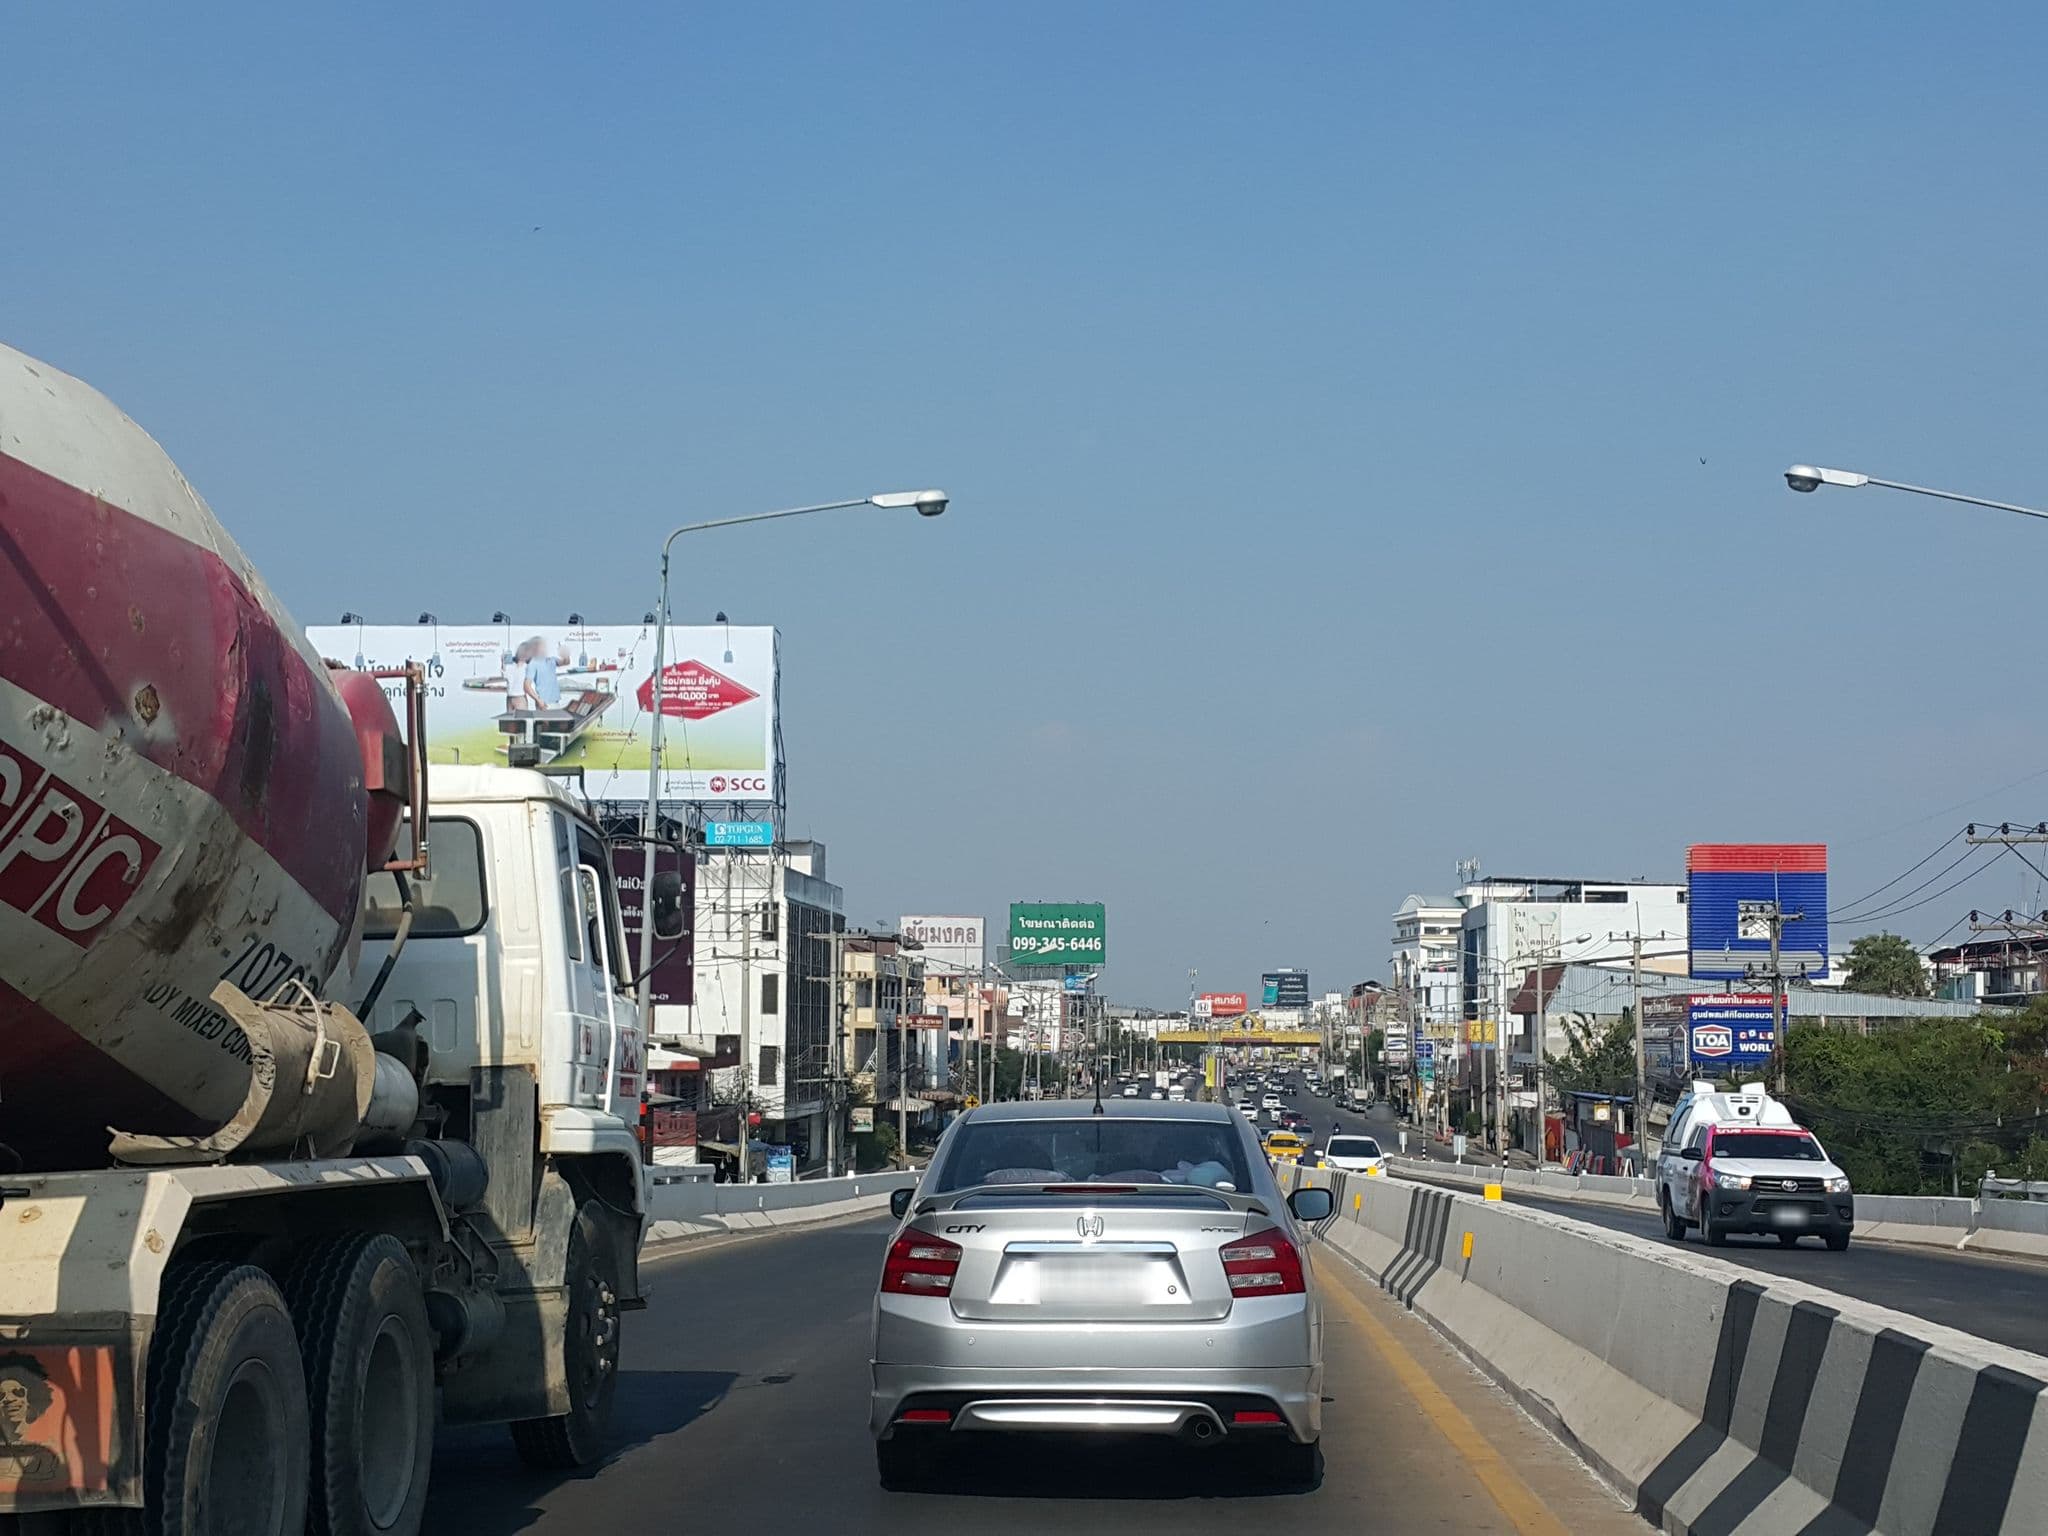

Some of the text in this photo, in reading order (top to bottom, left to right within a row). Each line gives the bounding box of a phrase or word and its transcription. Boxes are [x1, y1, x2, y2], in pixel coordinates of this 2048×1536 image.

[677, 692, 707, 701] 40,000
[730, 778, 766, 791] SCG
[1012, 936, 1101, 951] 099-345-6446
[170, 996, 227, 1040] MIXED
[1696, 1034, 1729, 1047] TOA
[1739, 1043, 1775, 1052] WORL
[945, 1224, 987, 1234] CITY
